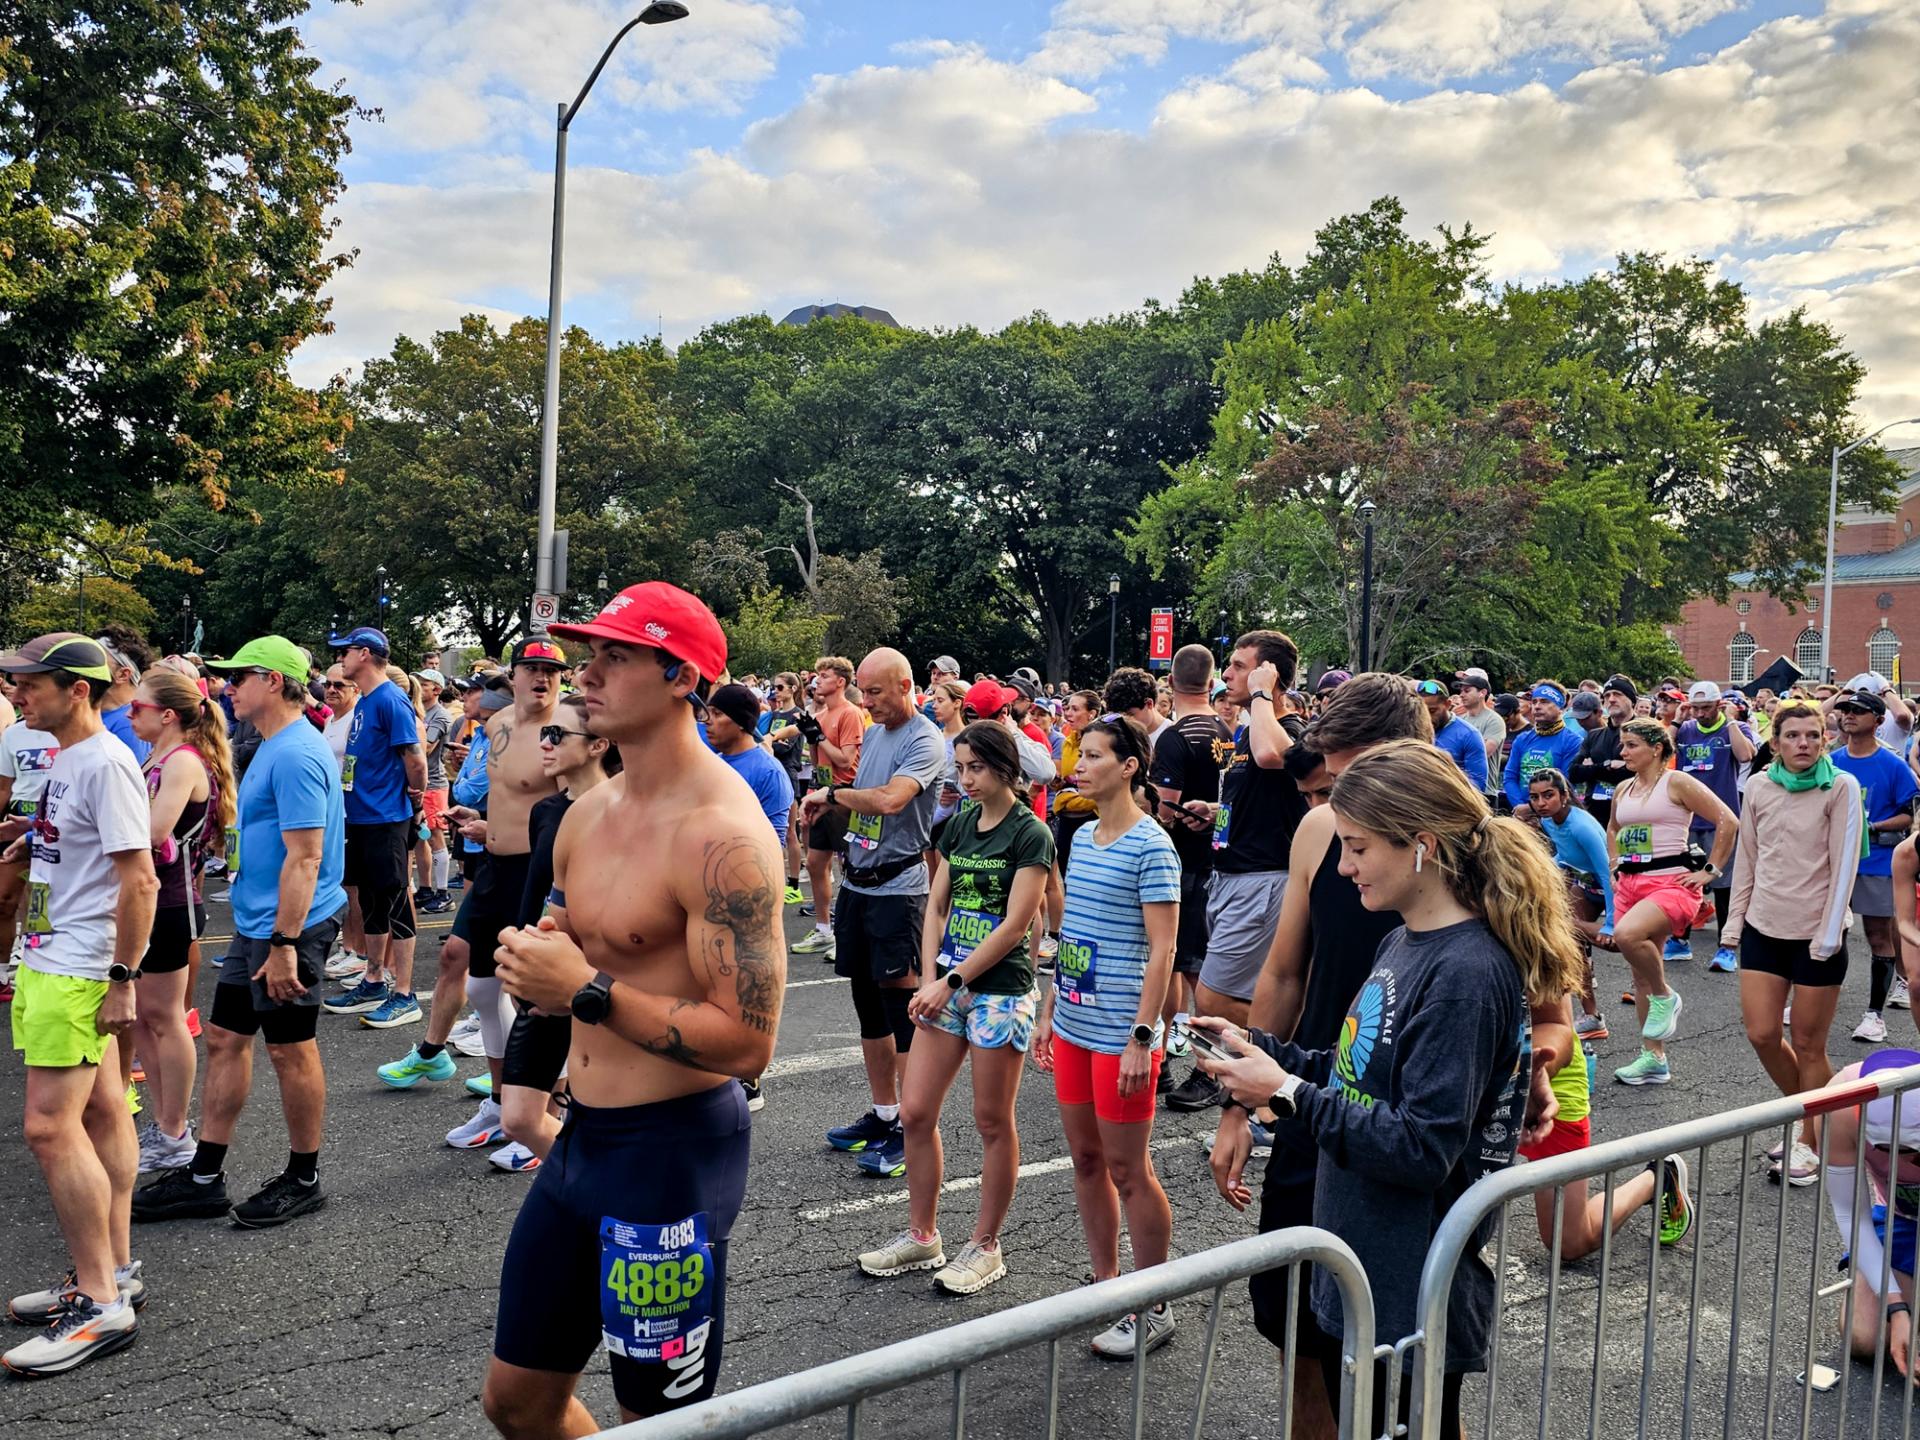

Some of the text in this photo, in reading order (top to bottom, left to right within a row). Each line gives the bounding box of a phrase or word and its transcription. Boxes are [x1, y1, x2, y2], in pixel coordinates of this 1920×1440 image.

[1157, 635, 1165, 654] B
[975, 859, 1007, 869] CLASSIC
[948, 913, 993, 942] 6466
[1059, 940, 1092, 973] 468
[1382, 1010, 1396, 1045] TALE
[658, 1218, 695, 1251] 4883
[628, 1251, 680, 1262] EVERSOURCE
[607, 1253, 704, 1306] 4883
[620, 1299, 690, 1317] HALF MARATHON
[628, 1346, 661, 1358] CORRAL:
